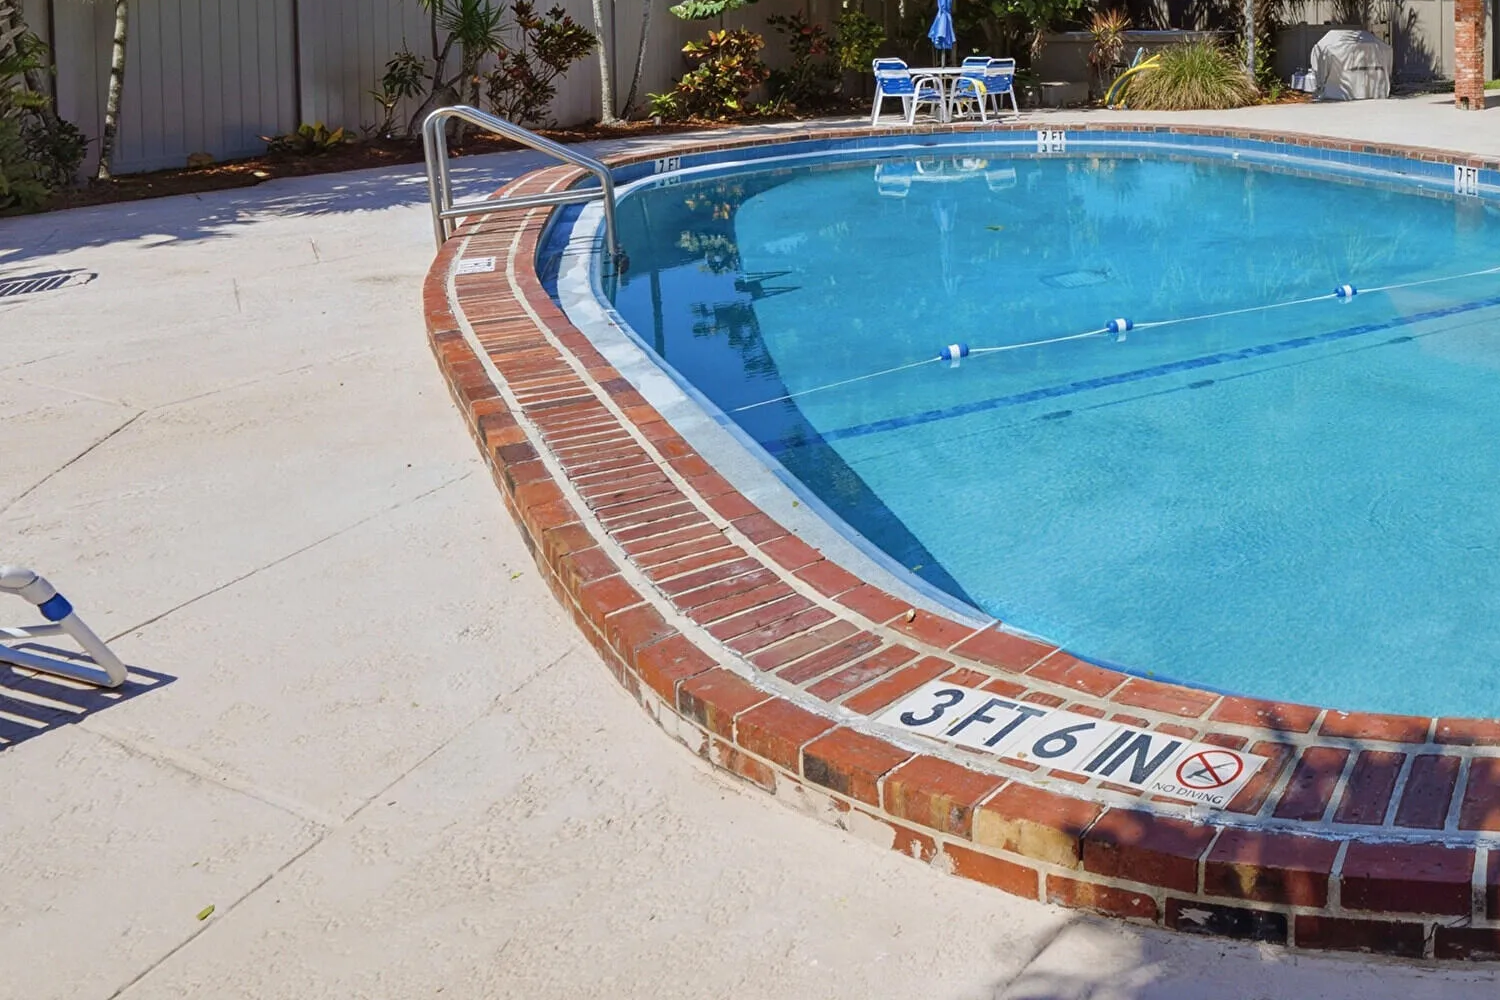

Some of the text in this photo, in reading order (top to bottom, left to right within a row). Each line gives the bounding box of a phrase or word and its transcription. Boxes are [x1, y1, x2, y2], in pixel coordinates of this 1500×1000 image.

[1041, 131, 1063, 141] 7 FT
[659, 157, 679, 173] 7 FT
[1466, 168, 1477, 183] FT
[900, 688, 1183, 786] 3 FT 6 IN
[1152, 782, 1224, 804] NO DIVING
